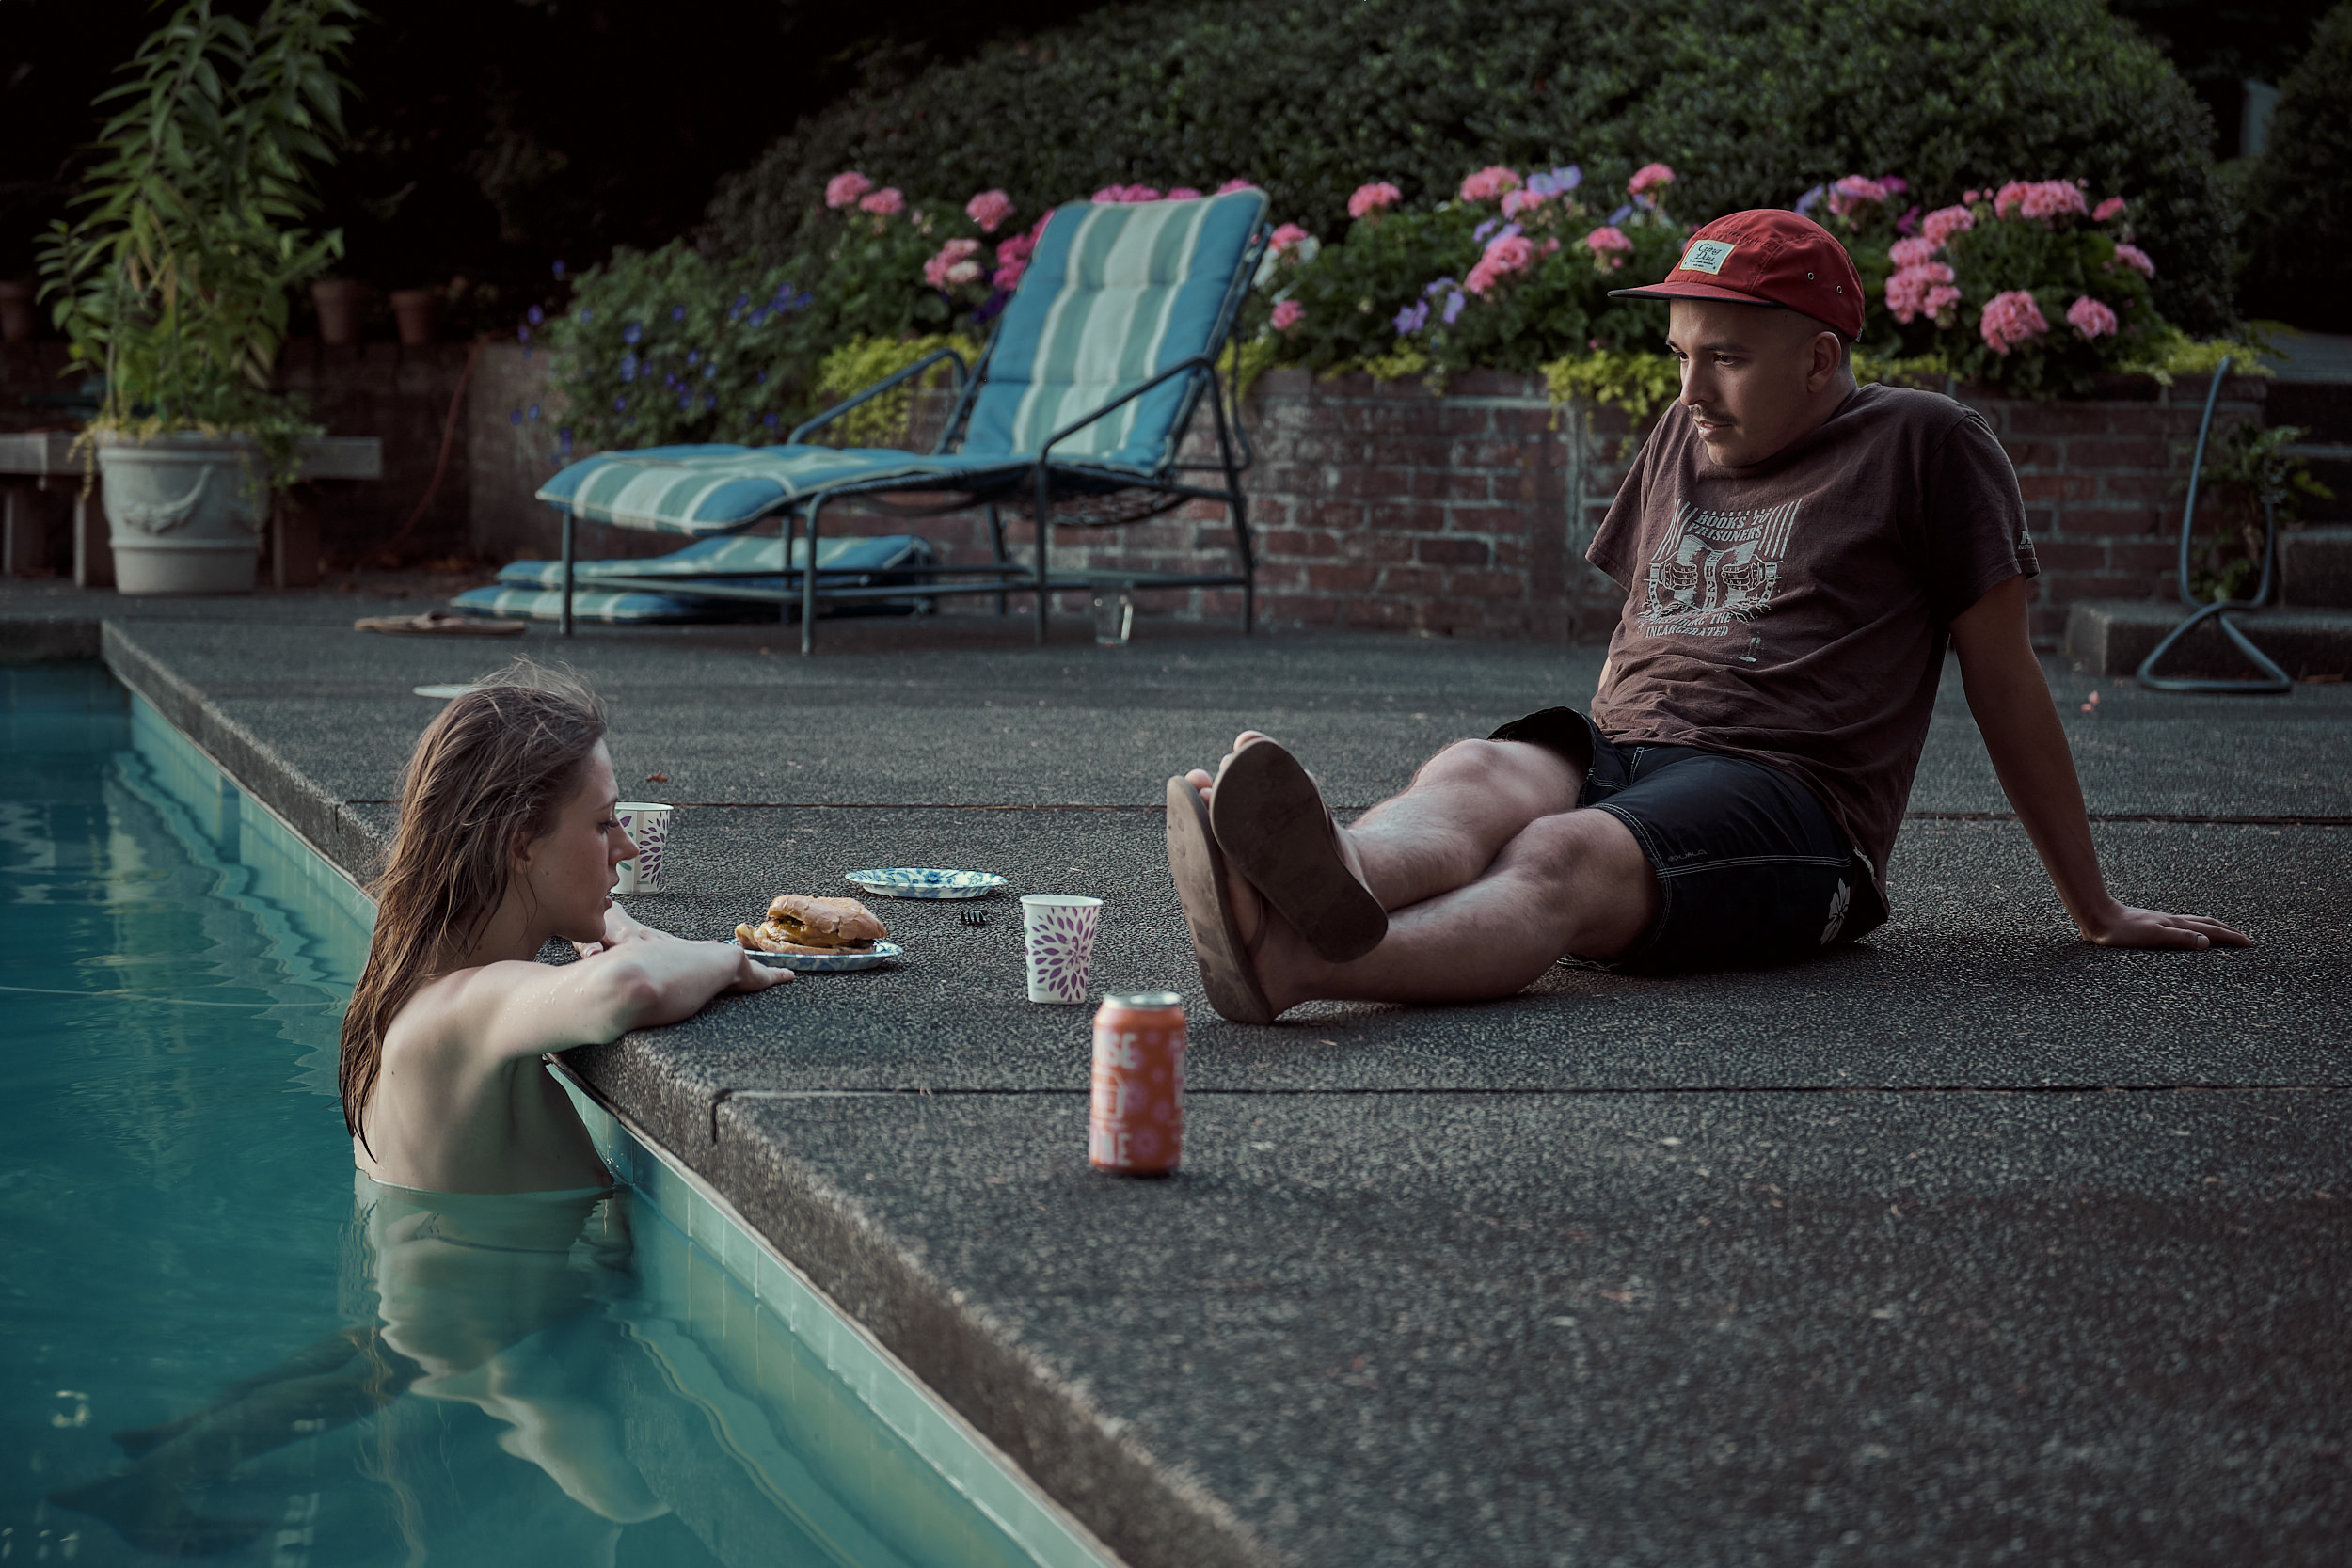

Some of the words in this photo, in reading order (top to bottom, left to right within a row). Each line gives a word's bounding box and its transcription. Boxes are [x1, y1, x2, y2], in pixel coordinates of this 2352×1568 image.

[1694, 514, 1747, 529] BOOKS
[1751, 513, 1770, 526] TO
[1686, 522, 1763, 542] PRISONERS
[1710, 612, 1733, 625] THE
[1645, 625, 1729, 639] INCARCERATED
